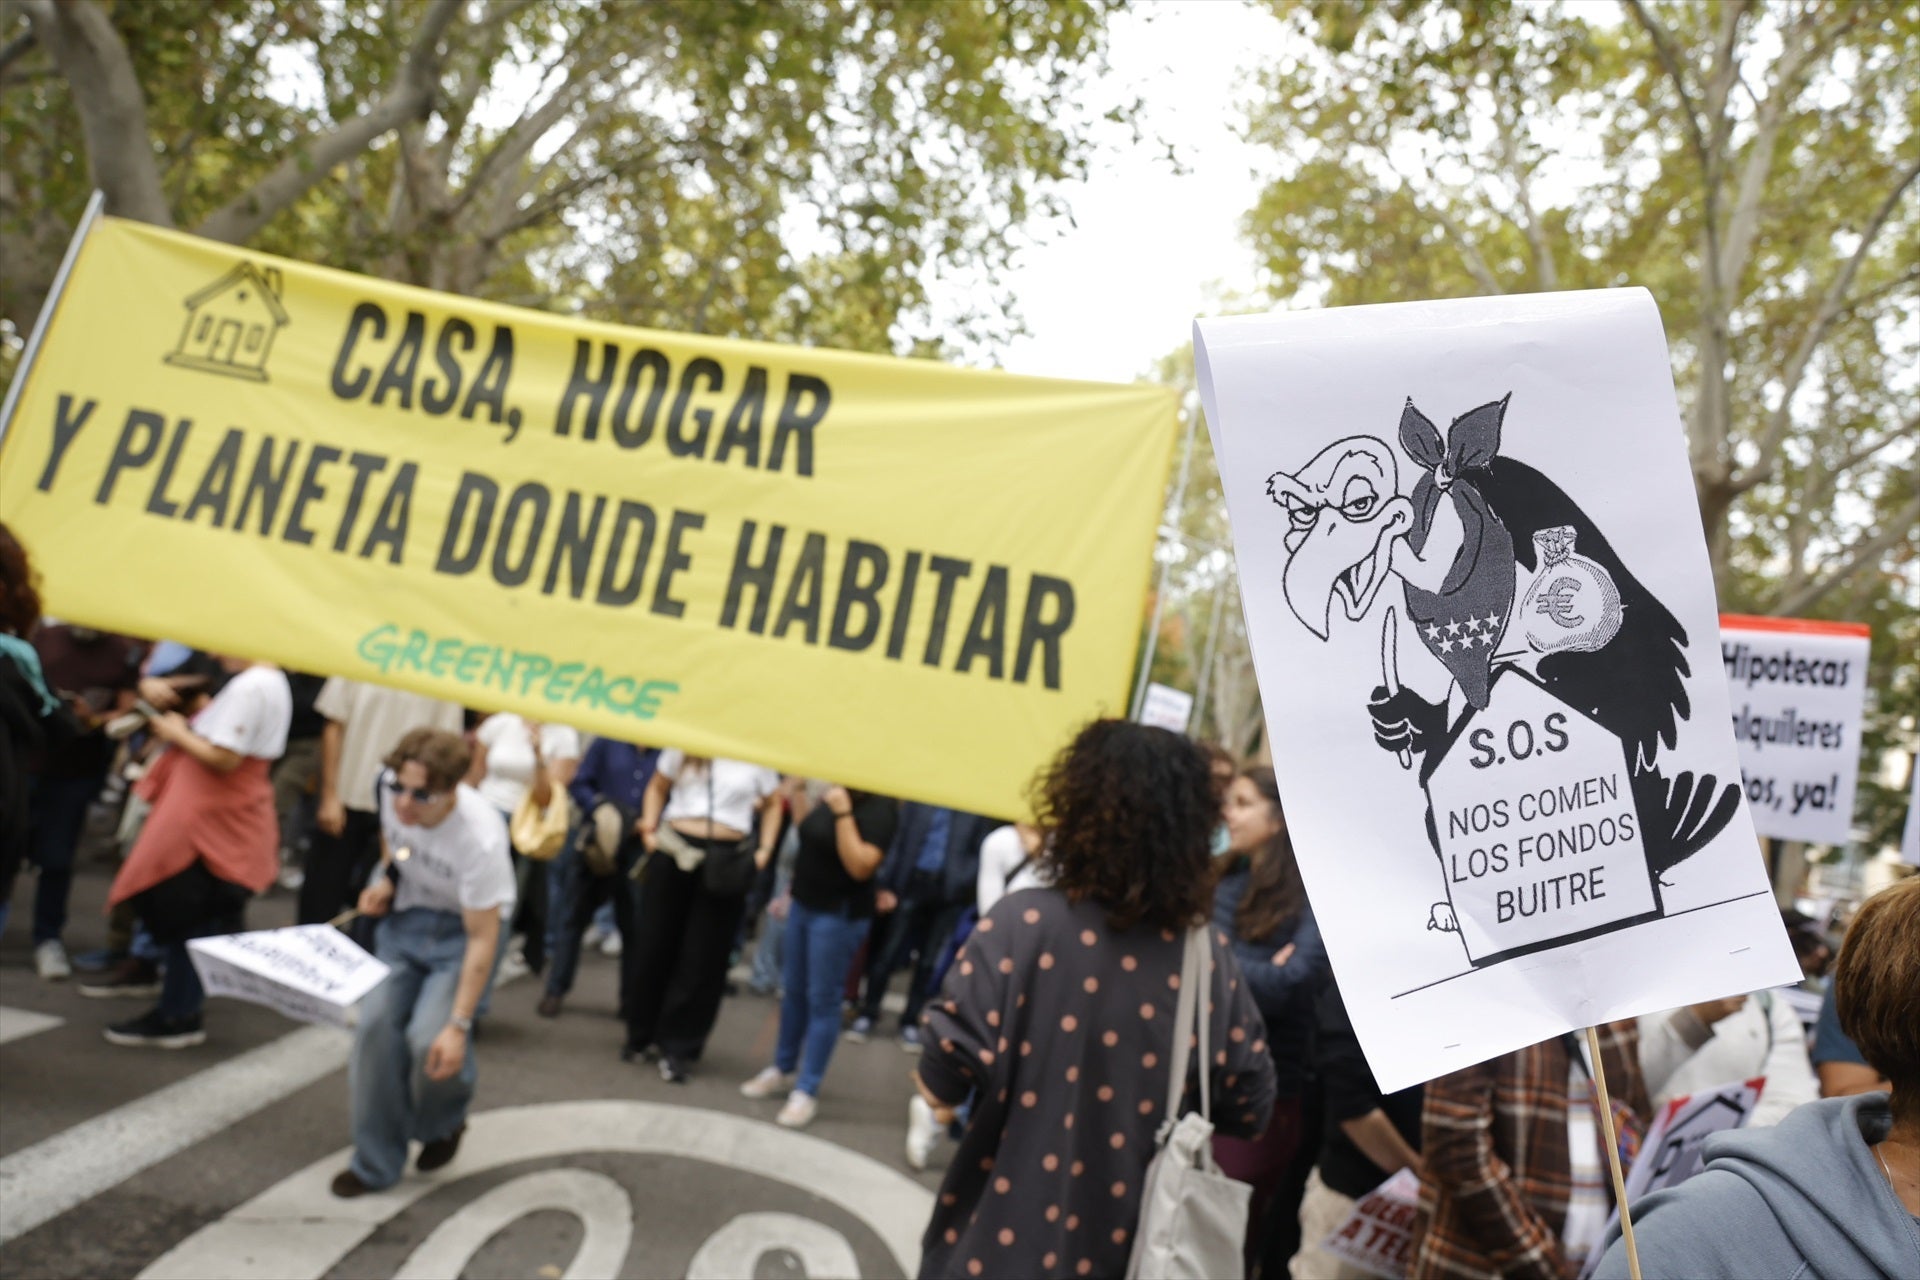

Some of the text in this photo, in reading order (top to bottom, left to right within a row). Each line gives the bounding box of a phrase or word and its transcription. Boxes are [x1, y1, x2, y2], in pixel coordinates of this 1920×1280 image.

[331, 302, 832, 477] CASA, HOGAR
[36, 393, 1076, 691] Y PLANETA DONDE HABITAR
[357, 624, 681, 720] GREENPEACE
[1468, 712, 1569, 769] S.O.S
[1449, 773, 1617, 839] NOS COMEN
[1790, 773, 1840, 816] ya!
[1451, 813, 1635, 883] LOS FONDOS
[1496, 865, 1606, 924] BUITRE
